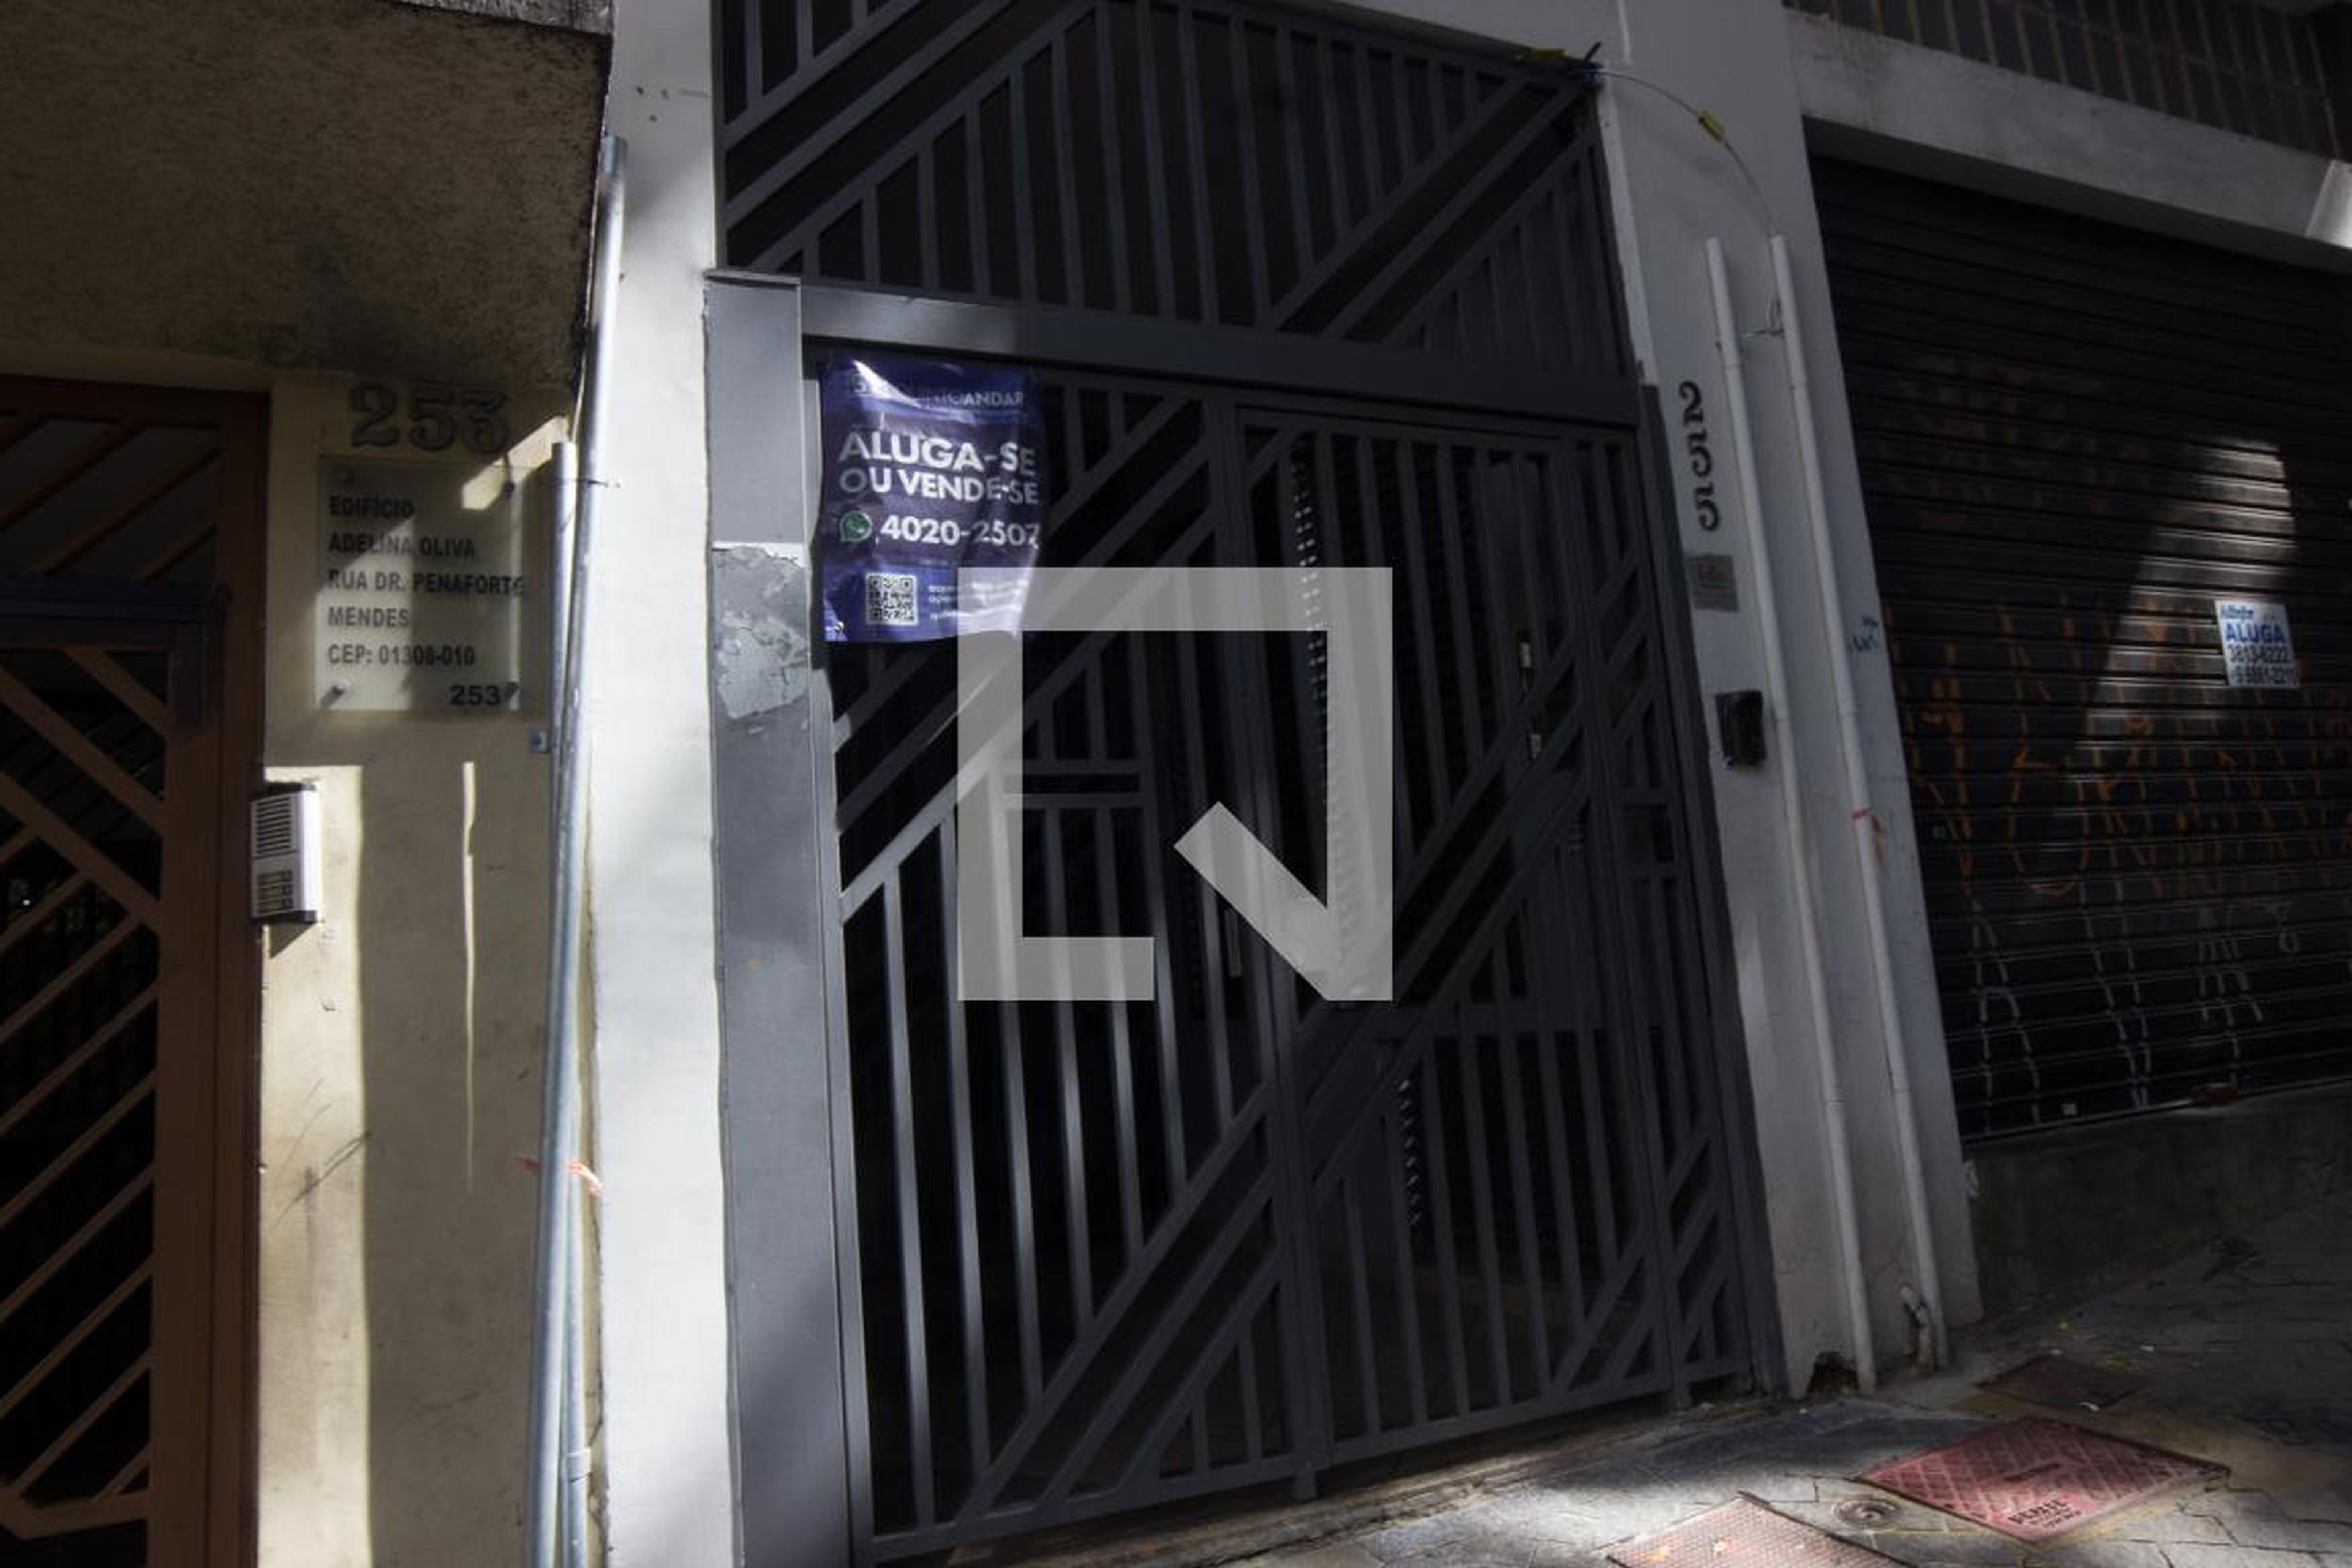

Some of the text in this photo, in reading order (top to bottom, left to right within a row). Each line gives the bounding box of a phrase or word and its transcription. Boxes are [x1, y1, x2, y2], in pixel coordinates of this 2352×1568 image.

[350, 384, 510, 455] 253
[839, 431, 1036, 477] ALUGA-SE
[1679, 380, 1720, 532] 255
[840, 467, 1039, 505] OU VENDE-SE
[880, 515, 1041, 546] 4020-2507
[328, 532, 475, 557] ADELINA OLIVA
[328, 569, 368, 591] RUA
[375, 571, 405, 591] DR.
[328, 606, 410, 628] MENDES
[2226, 622, 2287, 643] ALUGA
[328, 644, 372, 665] CEP:
[449, 685, 502, 706] 253
